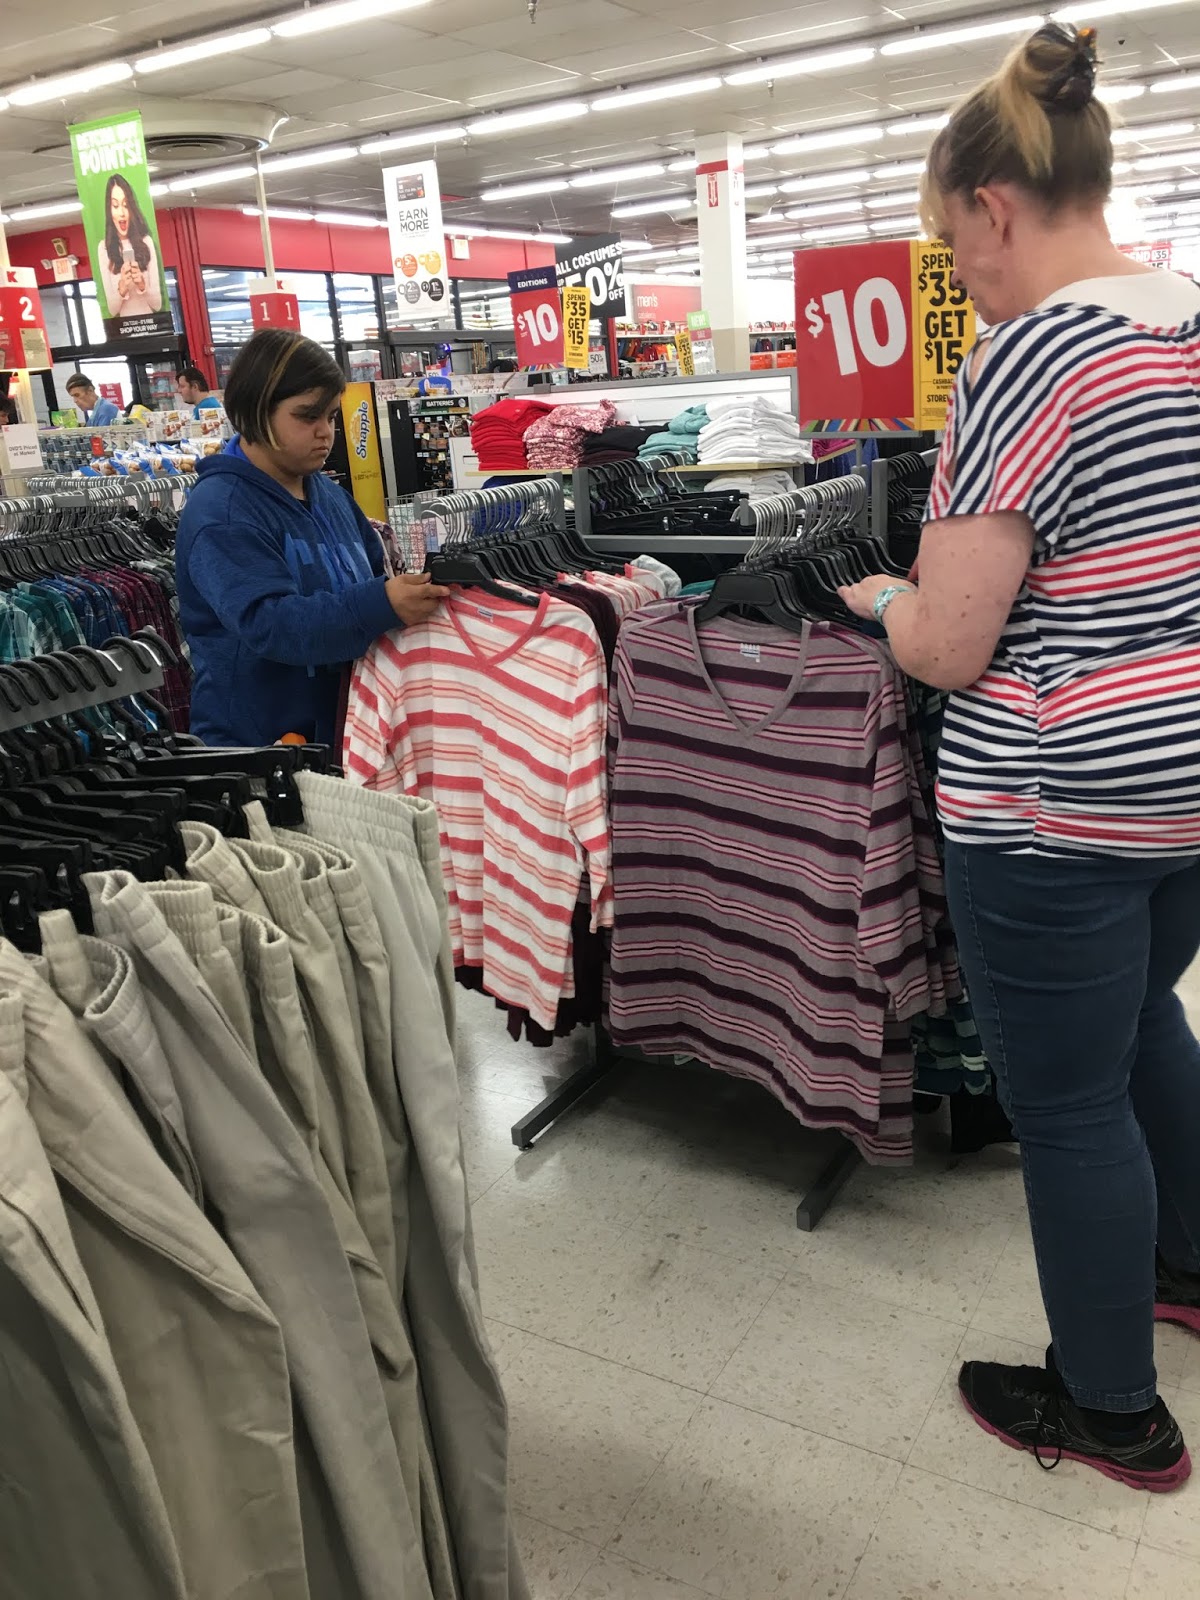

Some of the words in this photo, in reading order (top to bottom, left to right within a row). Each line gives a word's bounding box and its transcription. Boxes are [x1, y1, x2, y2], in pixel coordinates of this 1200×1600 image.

[79, 139, 143, 176] POINTS!
[399, 208, 429, 221] EARN
[400, 219, 430, 232] MORE
[555, 260, 571, 277] ALL
[572, 241, 623, 270] COSTUMES
[921, 252, 954, 270] SPEN
[517, 278, 548, 288] EDITIONS
[918, 270, 968, 306] $35
[19, 296, 36, 321] 2
[636, 292, 658, 307] men's
[260, 301, 271, 321] 1
[285, 301, 294, 320] 1
[566, 301, 587, 317] $35
[146, 323, 158, 331] WAY
[516, 303, 559, 347] $10
[568, 318, 586, 331] GET
[804, 276, 907, 376] $10
[925, 310, 967, 339] GET
[567, 330, 584, 346] $15
[924, 339, 964, 375] $15
[426, 400, 455, 408] BATTERIES
[926, 394, 949, 403] STORE
[355, 400, 370, 459] Snapple
